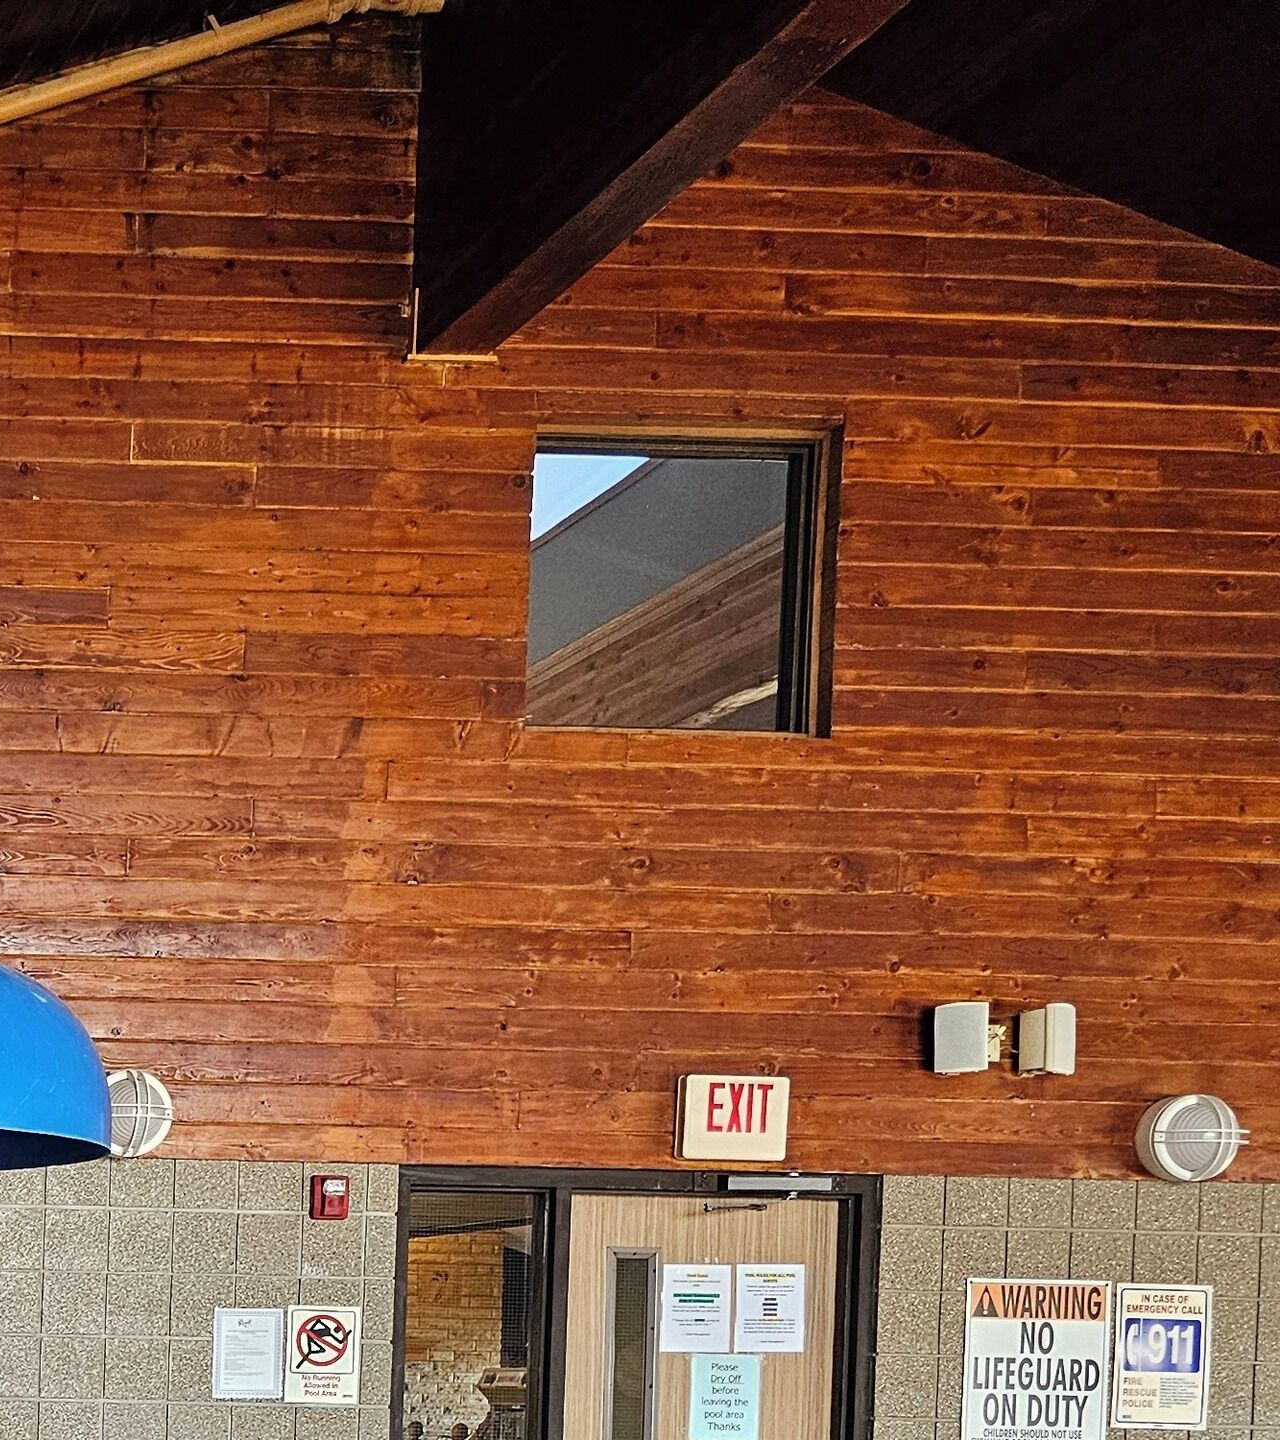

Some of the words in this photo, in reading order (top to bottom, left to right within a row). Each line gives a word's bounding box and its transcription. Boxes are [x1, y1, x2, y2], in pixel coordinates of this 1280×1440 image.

[707, 1083, 774, 1133] EXIT
[1001, 1285, 1102, 1320] WARNING
[1141, 1294, 1151, 1303] IN
[1153, 1294, 1176, 1304] CASE
[1177, 1295, 1189, 1304] OF
[1126, 1304, 1179, 1315] EMERGENCY
[1181, 1305, 1203, 1315] CALL
[1020, 1321, 1054, 1354] NO
[1148, 1324, 1195, 1365] 911
[711, 1363, 738, 1371] Please
[711, 1375, 725, 1384] Dry
[729, 1375, 742, 1384] Off
[972, 1357, 1100, 1392] LIFEGUARD
[1123, 1377, 1143, 1385] FIRE
[712, 1386, 739, 1394] before
[1122, 1388, 1157, 1397] RESCUE
[702, 1397, 732, 1408] leaving
[734, 1398, 749, 1406] the
[1122, 1399, 1153, 1408] POLICE
[704, 1410, 723, 1419] pool
[983, 1393, 1017, 1426] ON
[1027, 1395, 1088, 1428] DUTY
[707, 1422, 741, 1431] Thanks
[983, 1428, 1018, 1438] CHILDREN
[1020, 1429, 1049, 1439] SHOULD
[1051, 1430, 1067, 1439] NOT
[1068, 1430, 1082, 1439] USE
